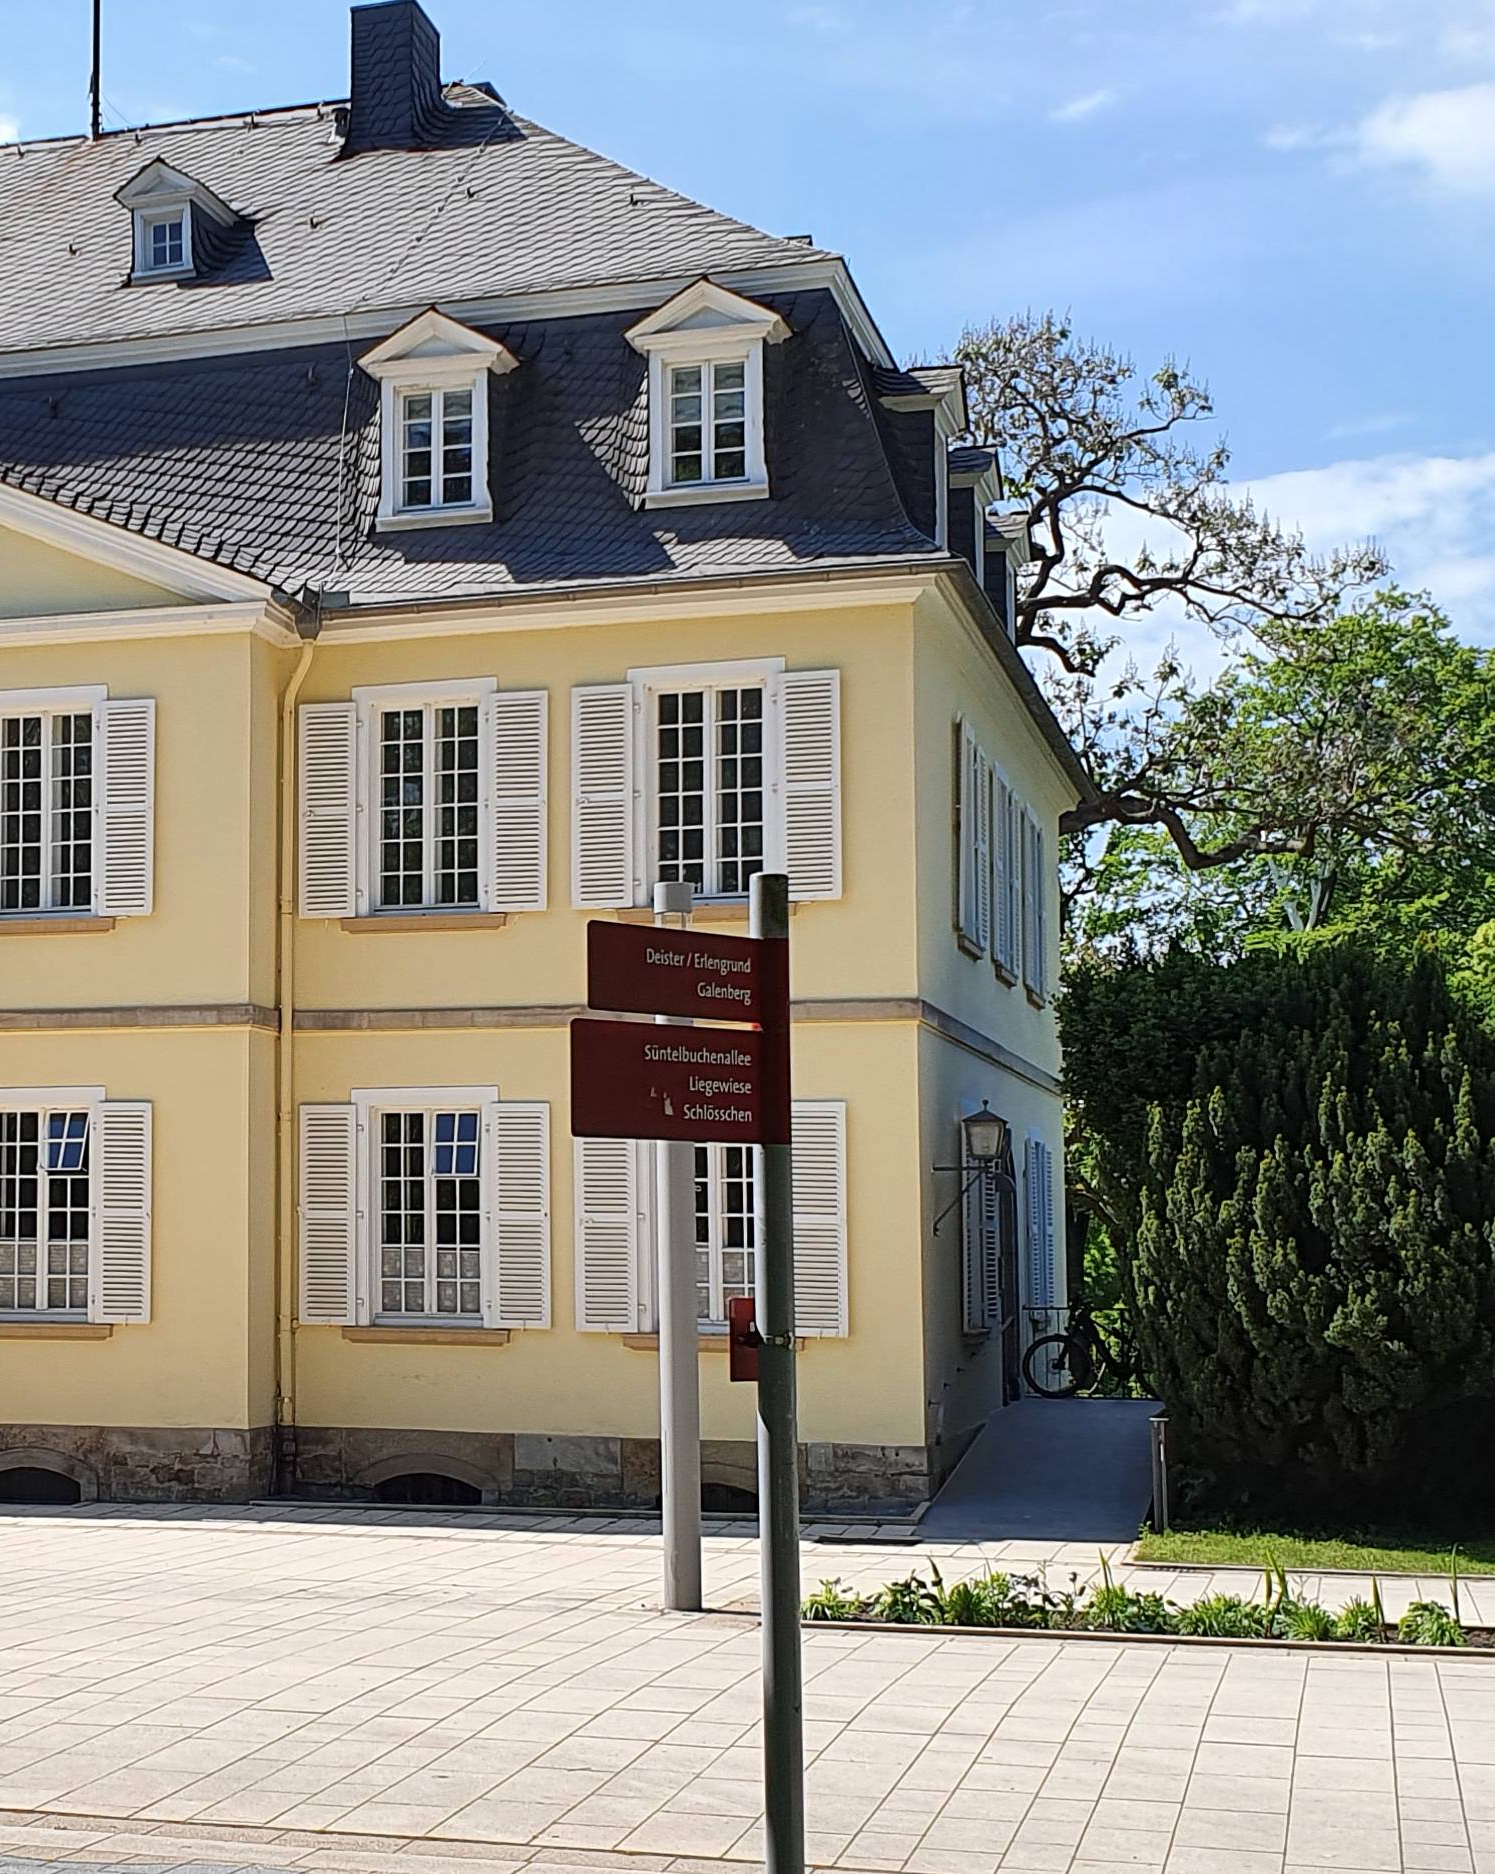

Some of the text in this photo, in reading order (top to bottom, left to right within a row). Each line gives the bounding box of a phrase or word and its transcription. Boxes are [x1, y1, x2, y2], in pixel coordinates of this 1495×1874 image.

[646, 948, 751, 976] Deister / Erlengrund
[697, 982, 751, 1006] Galenberg
[644, 1044, 752, 1066] Süntelbuchenallee
[689, 1075, 752, 1097] Liegewiese
[683, 1104, 752, 1122] Schlösschen
